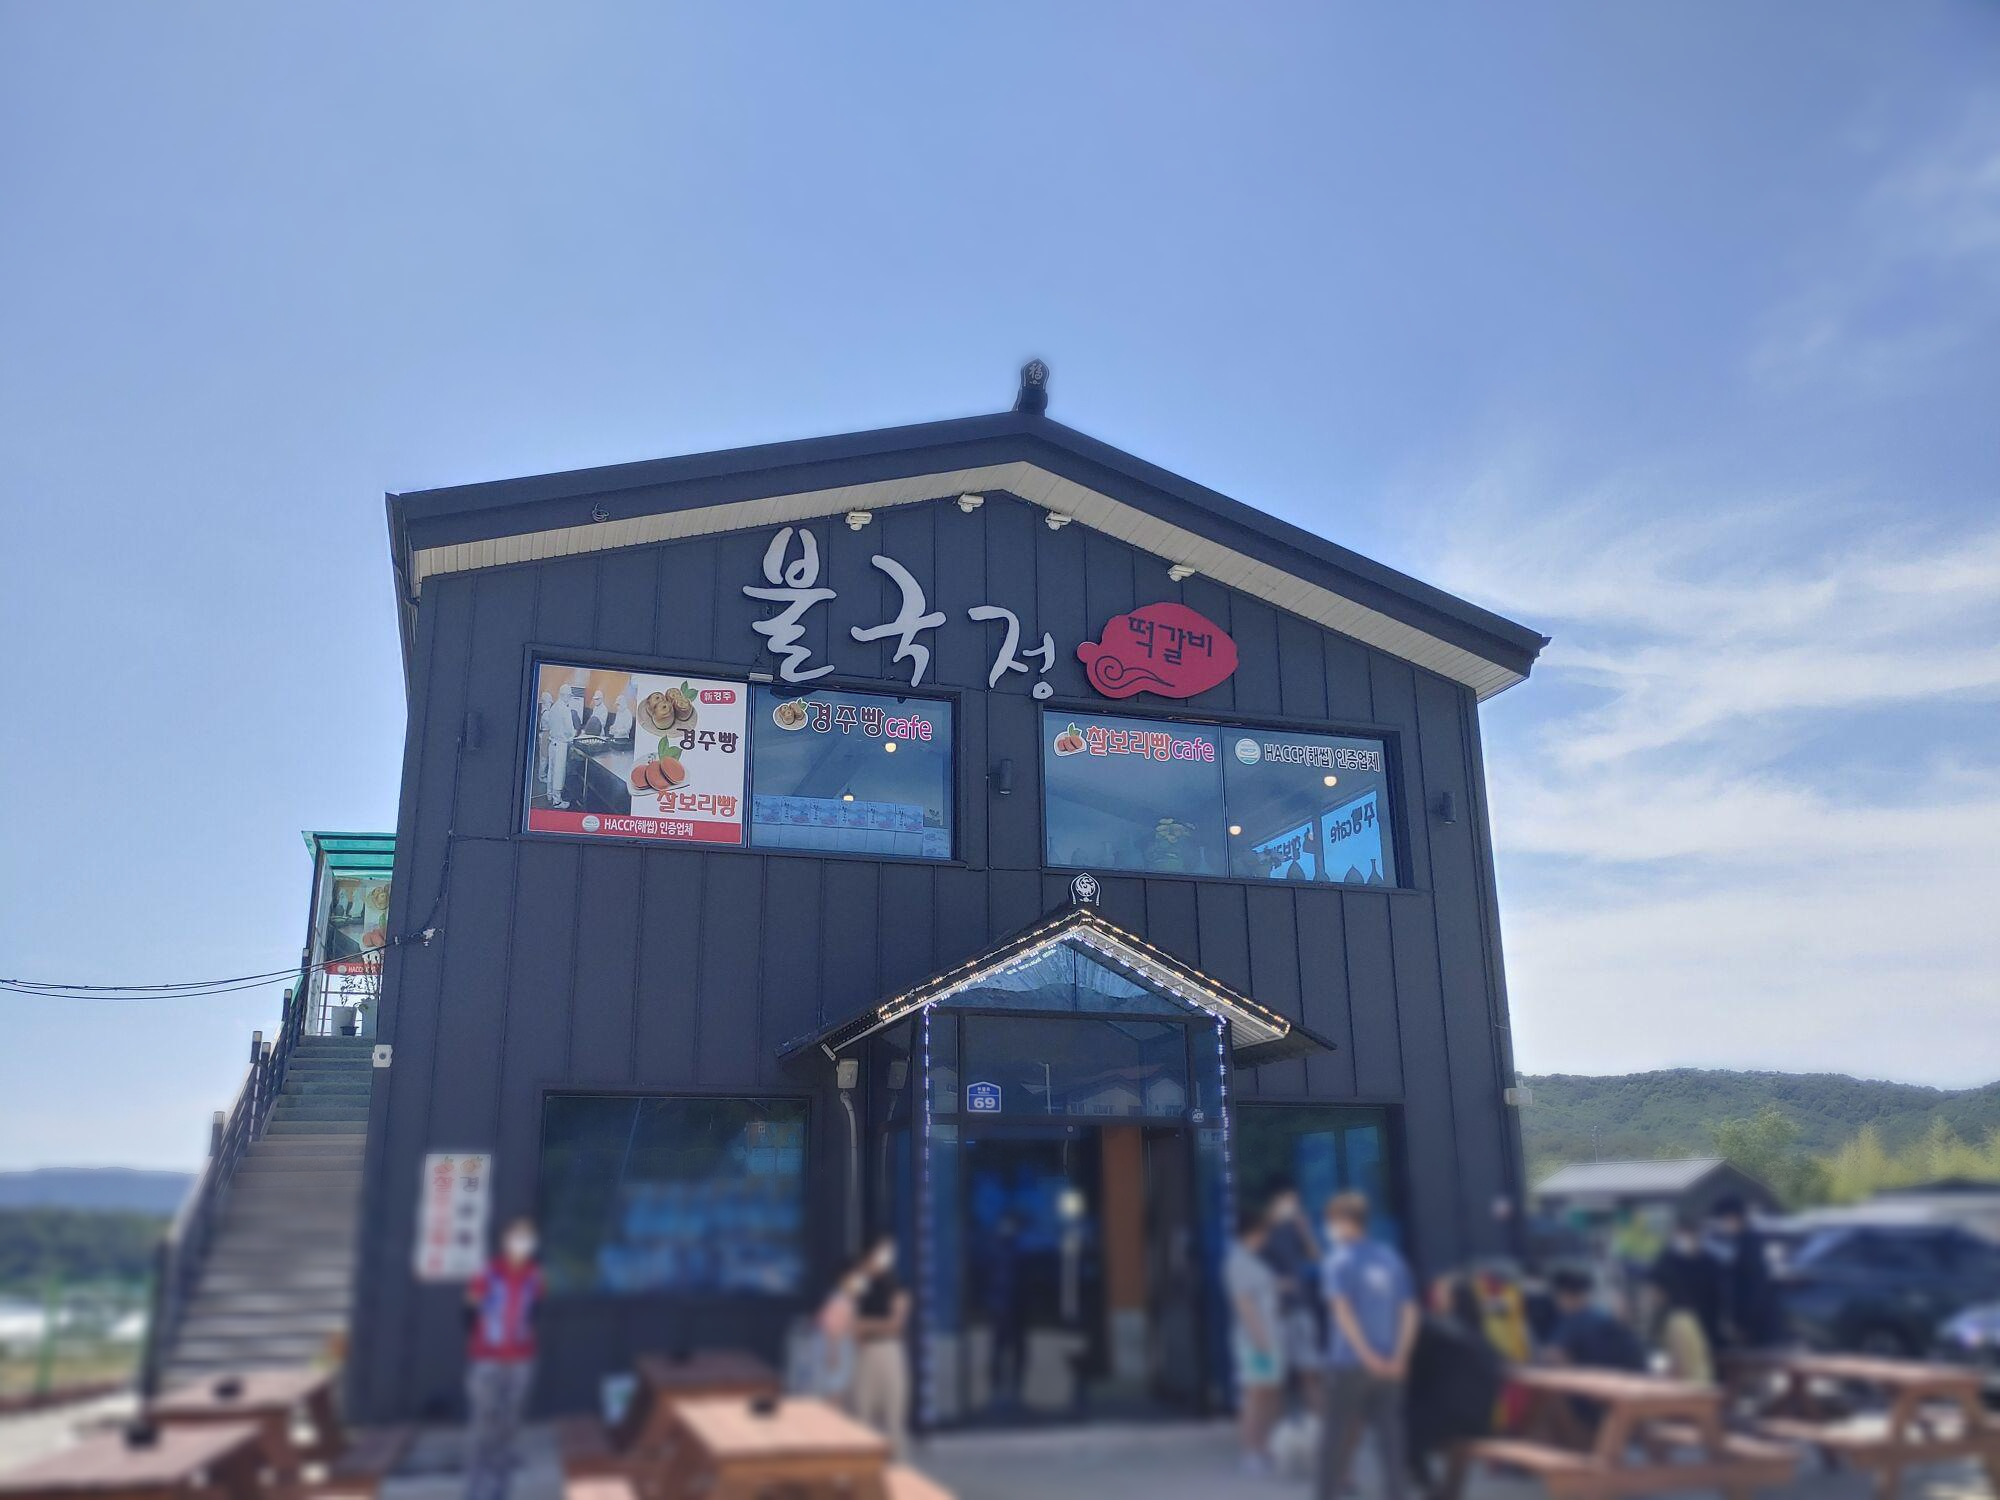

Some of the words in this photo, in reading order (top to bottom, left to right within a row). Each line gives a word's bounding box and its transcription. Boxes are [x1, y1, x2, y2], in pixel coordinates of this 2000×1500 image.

[742, 526, 1055, 700] 불국정
[1128, 616, 1213, 665] 떡갈비
[676, 728, 739, 754] 경주빵
[1264, 743, 1334, 769] HACCP(해썹)
[1335, 748, 1381, 772] 인증업체
[657, 789, 738, 817] 찰보리빵
[604, 818, 658, 835] HACCP(해썹)
[659, 821, 693, 836] 인증업체
[973, 1097, 996, 1109] 69
